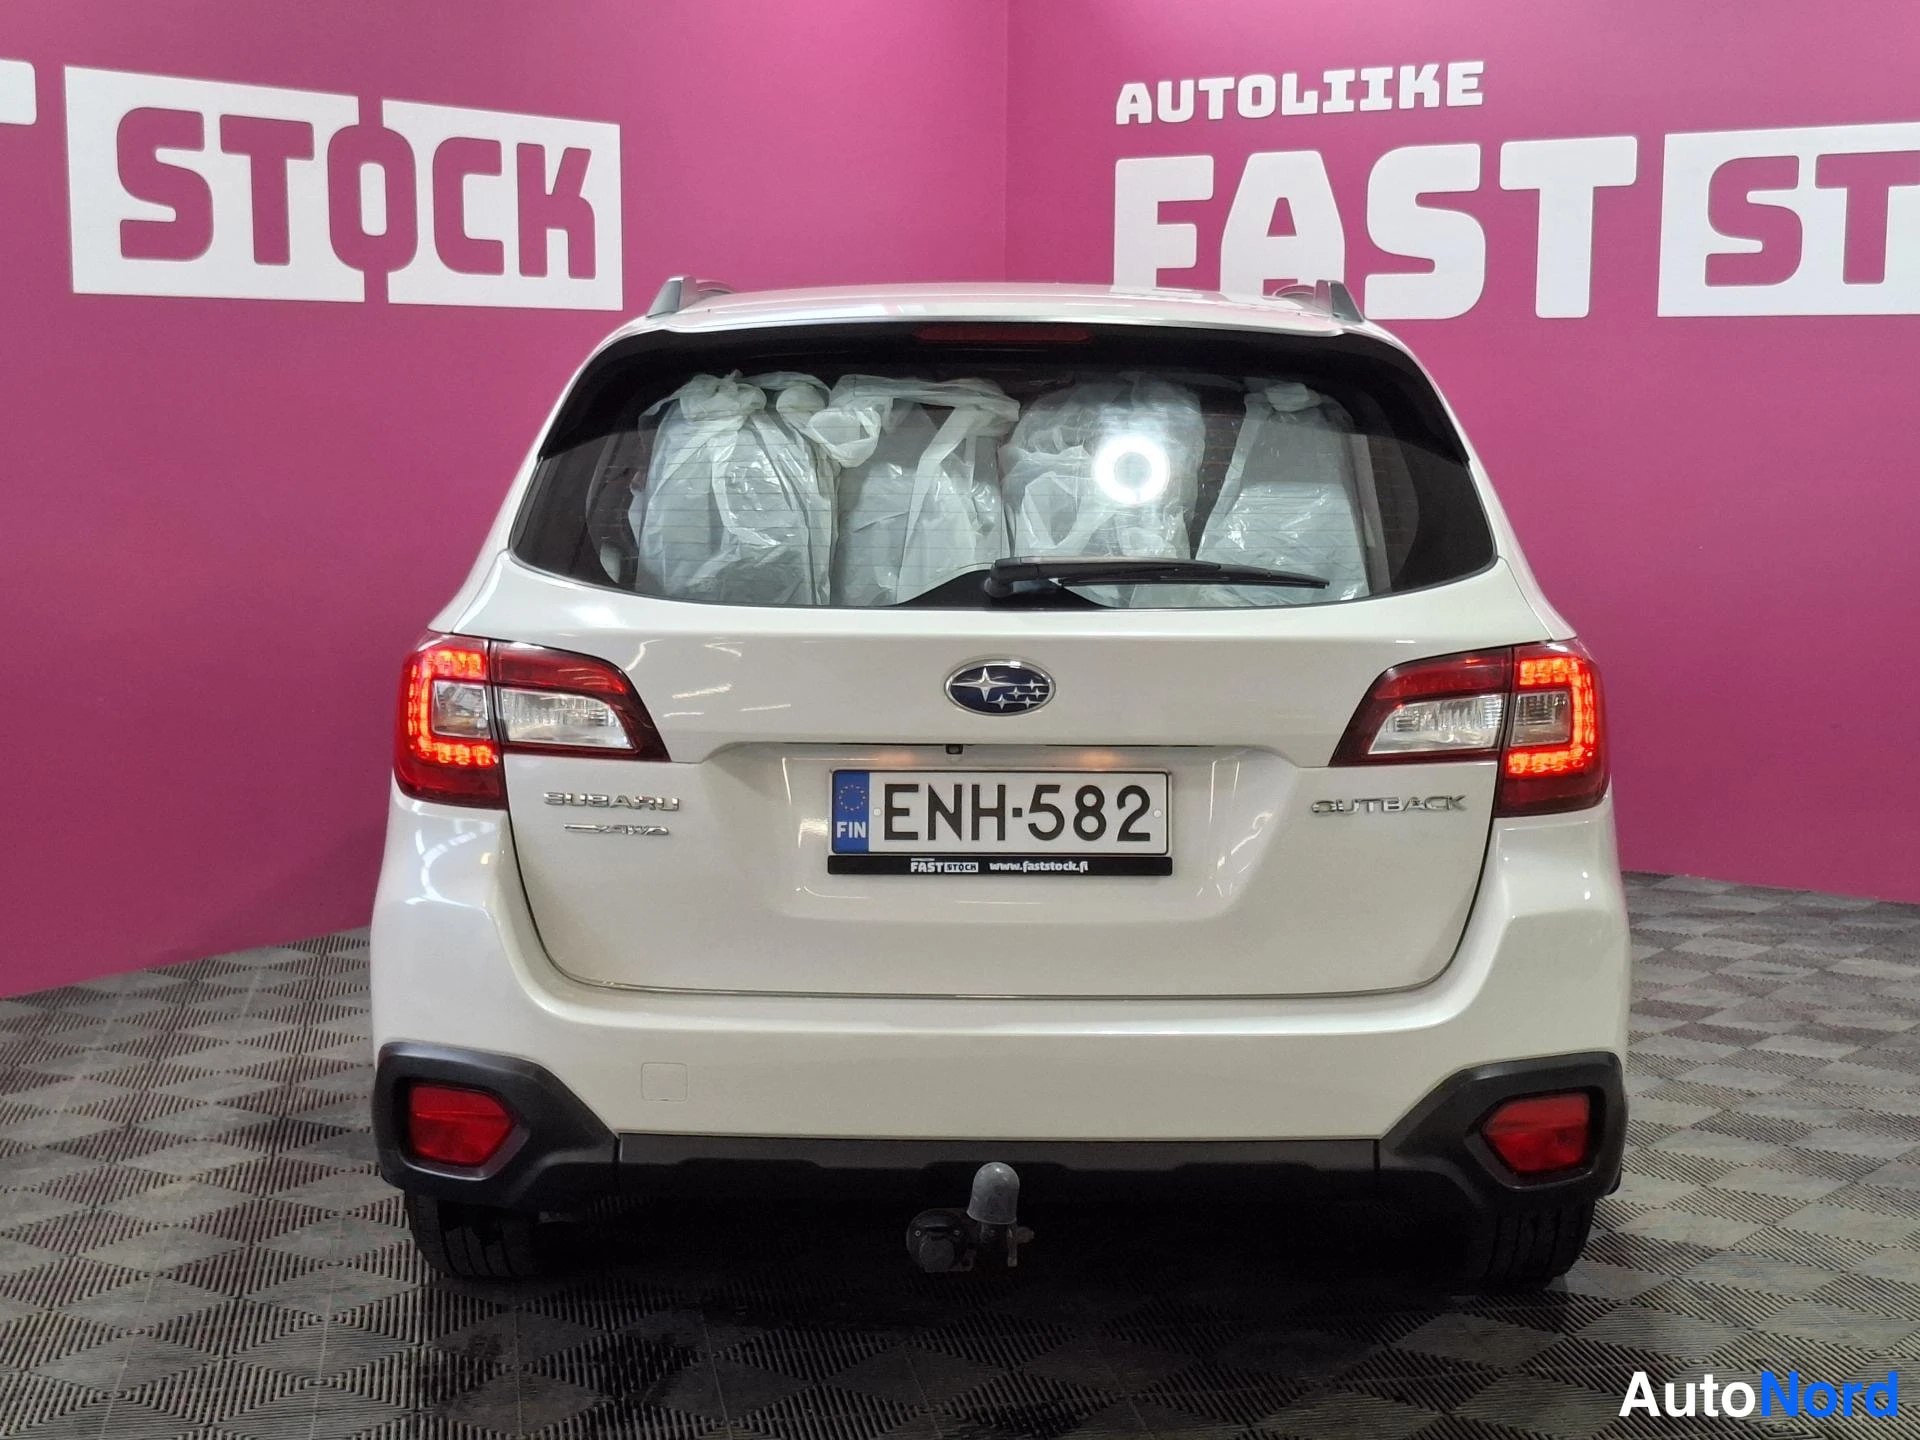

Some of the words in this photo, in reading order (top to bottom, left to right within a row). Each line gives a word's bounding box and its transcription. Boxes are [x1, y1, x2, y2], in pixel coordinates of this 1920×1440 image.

[1115, 60, 1485, 125] AUTOLIIKE
[116, 106, 597, 280] STOCK
[1113, 136, 1638, 320] FAST
[543, 791, 681, 811] SUBARU
[883, 783, 1151, 841] ENH-582
[1311, 795, 1467, 814] OUTBACK
[836, 821, 867, 839] FIN
[988, 860, 1089, 873] www.faststock.fi
